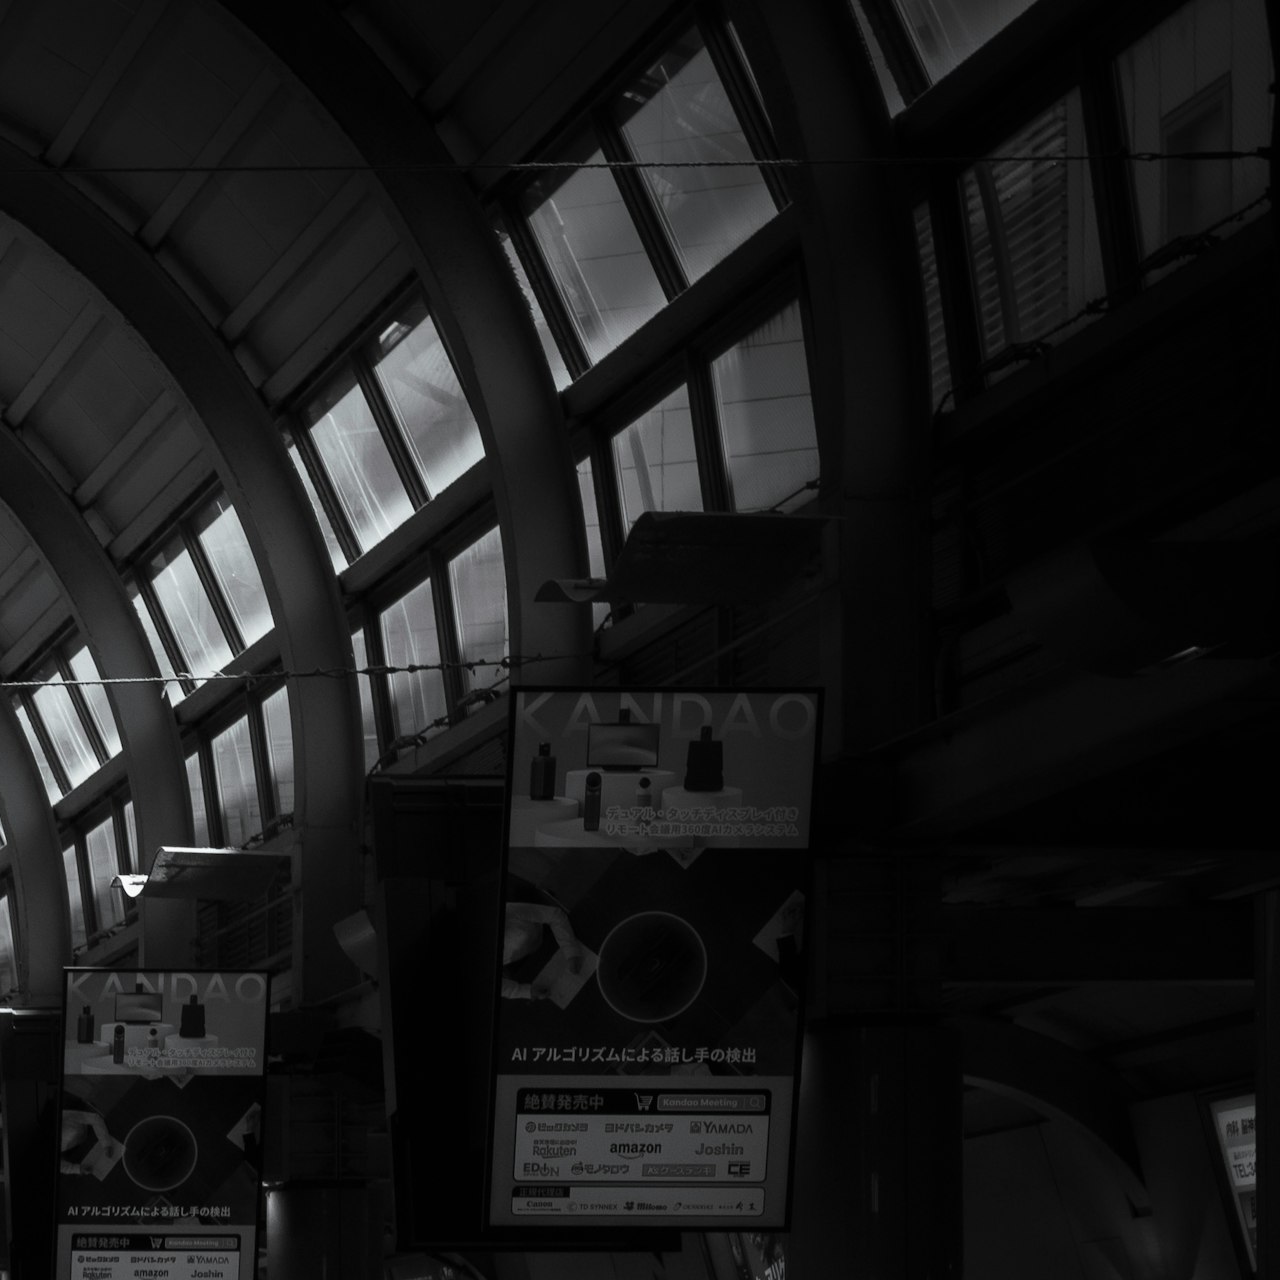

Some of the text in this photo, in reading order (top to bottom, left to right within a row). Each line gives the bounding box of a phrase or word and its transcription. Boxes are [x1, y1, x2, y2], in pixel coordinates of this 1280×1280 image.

[515, 692, 816, 738] KANDAO
[66, 972, 267, 1003] KANDAO
[511, 1047, 757, 1063] AI アルゴリズムによる話し手の検出
[523, 1093, 605, 1111] 絶賛発売中
[663, 1098, 737, 1109] Kandao Meeting
[605, 1123, 674, 1133] ヨドバシカメラ
[703, 1121, 753, 1134] YAMADA
[533, 1146, 577, 1156] Rakuten
[610, 1143, 662, 1154] amazon
[695, 1143, 743, 1155] Joshin
[585, 1164, 629, 1174] モノタロウ
[67, 1206, 231, 1217] AI アルゴリズムによる話し手の検出
[196, 1255, 229, 1264] YAMADA
[190, 1270, 223, 1278] Joshin
